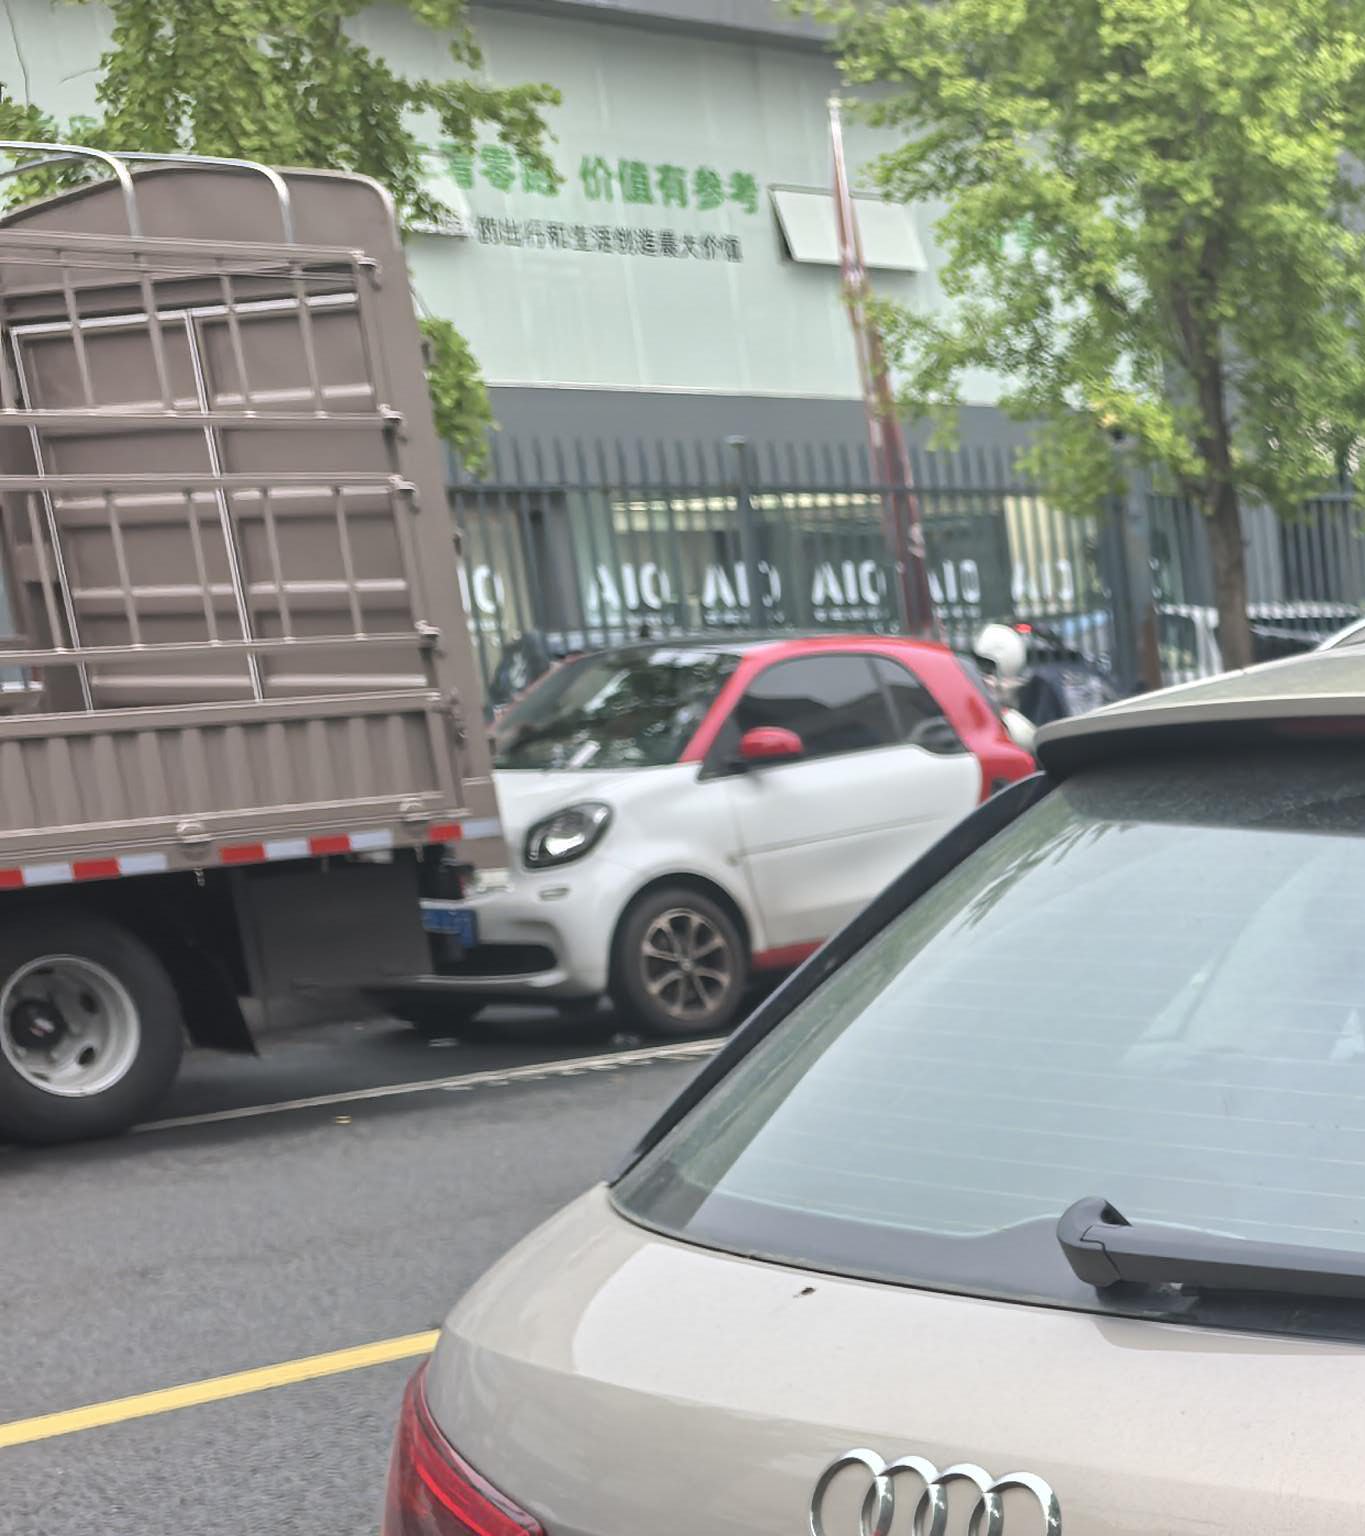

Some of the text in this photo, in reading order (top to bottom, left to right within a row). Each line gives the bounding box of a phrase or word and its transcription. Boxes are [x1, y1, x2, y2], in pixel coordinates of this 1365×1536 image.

[579, 155, 758, 214] 价值有参考
